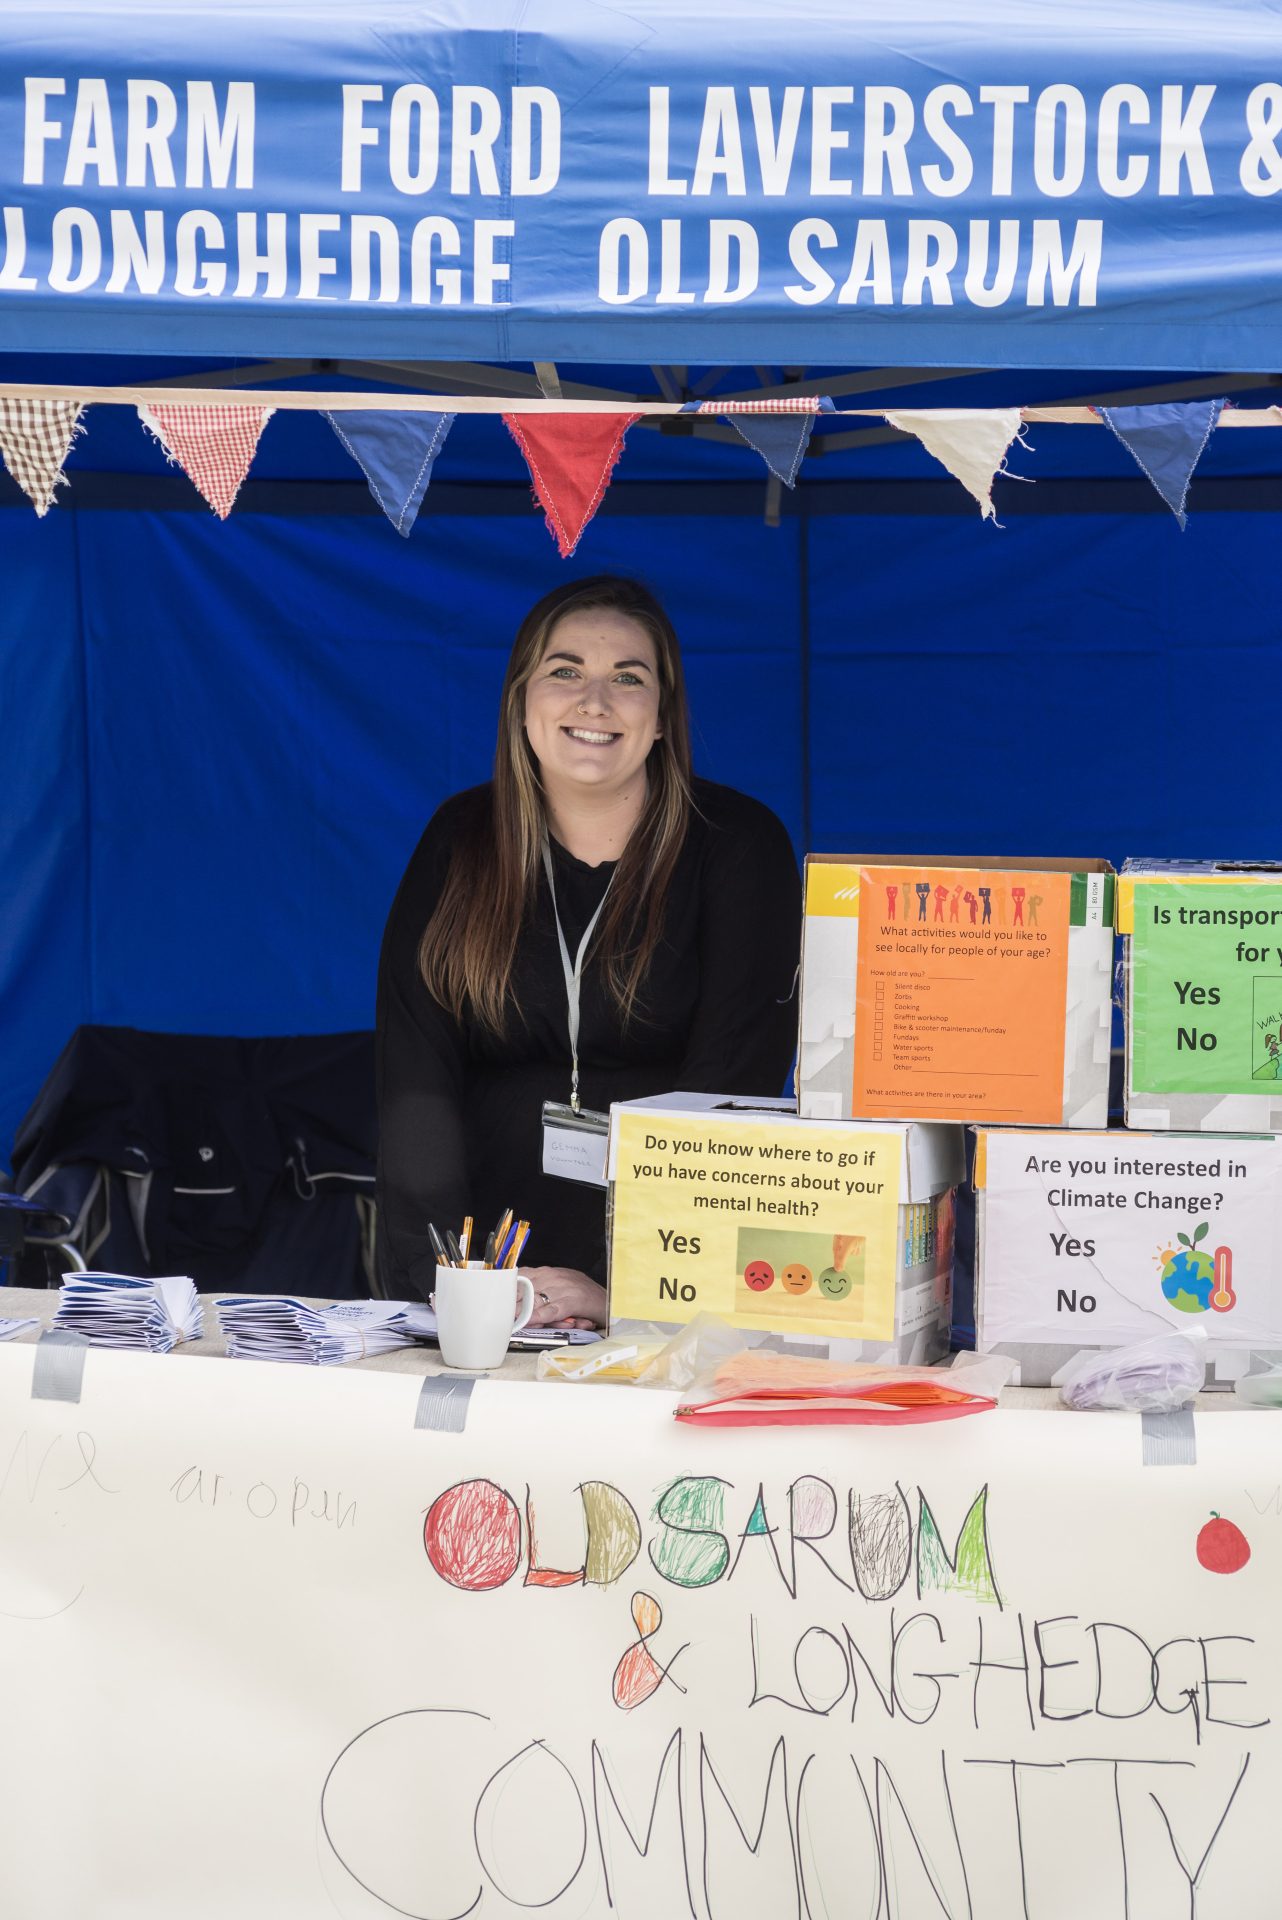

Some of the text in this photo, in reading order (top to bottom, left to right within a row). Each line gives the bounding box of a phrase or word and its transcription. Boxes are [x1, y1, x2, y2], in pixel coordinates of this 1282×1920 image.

[23, 76, 1282, 198] FARM FORD LAVERSTOCK &
[0, 206, 1104, 307] LONGHEDGE OLD SARUM
[1154, 905, 1282, 929] Is transpor
[880, 926, 1047, 941] What activities would you like to
[875, 943, 1051, 960] see locally for people of your age?
[1236, 942, 1270, 962] for
[870, 969, 885, 977] How
[909, 971, 925, 979] you?
[1174, 981, 1221, 1006] Yes
[894, 1003, 920, 1011] Cooking
[894, 1013, 916, 1021] Graffiti
[893, 1023, 907, 1031] Bike
[915, 1024, 939, 1032] scooter
[1177, 1027, 1217, 1051] No
[866, 1088, 884, 1096] What
[885, 1089, 913, 1097] activities
[952, 1092, 967, 1100] your
[644, 1135, 876, 1168] Do you know where to go if
[1025, 1155, 1247, 1178] Are you interested in
[633, 1163, 884, 1195] you have concerns about your
[694, 1194, 819, 1217] mental health?
[1047, 1188, 1224, 1214] Climate Change?
[657, 1229, 701, 1255] Yes
[1049, 1233, 1096, 1258] Yes
[659, 1277, 697, 1303] No
[1057, 1289, 1097, 1314] No
[423, 1474, 1004, 1612] OLD SARUM
[612, 1591, 692, 1711] &
